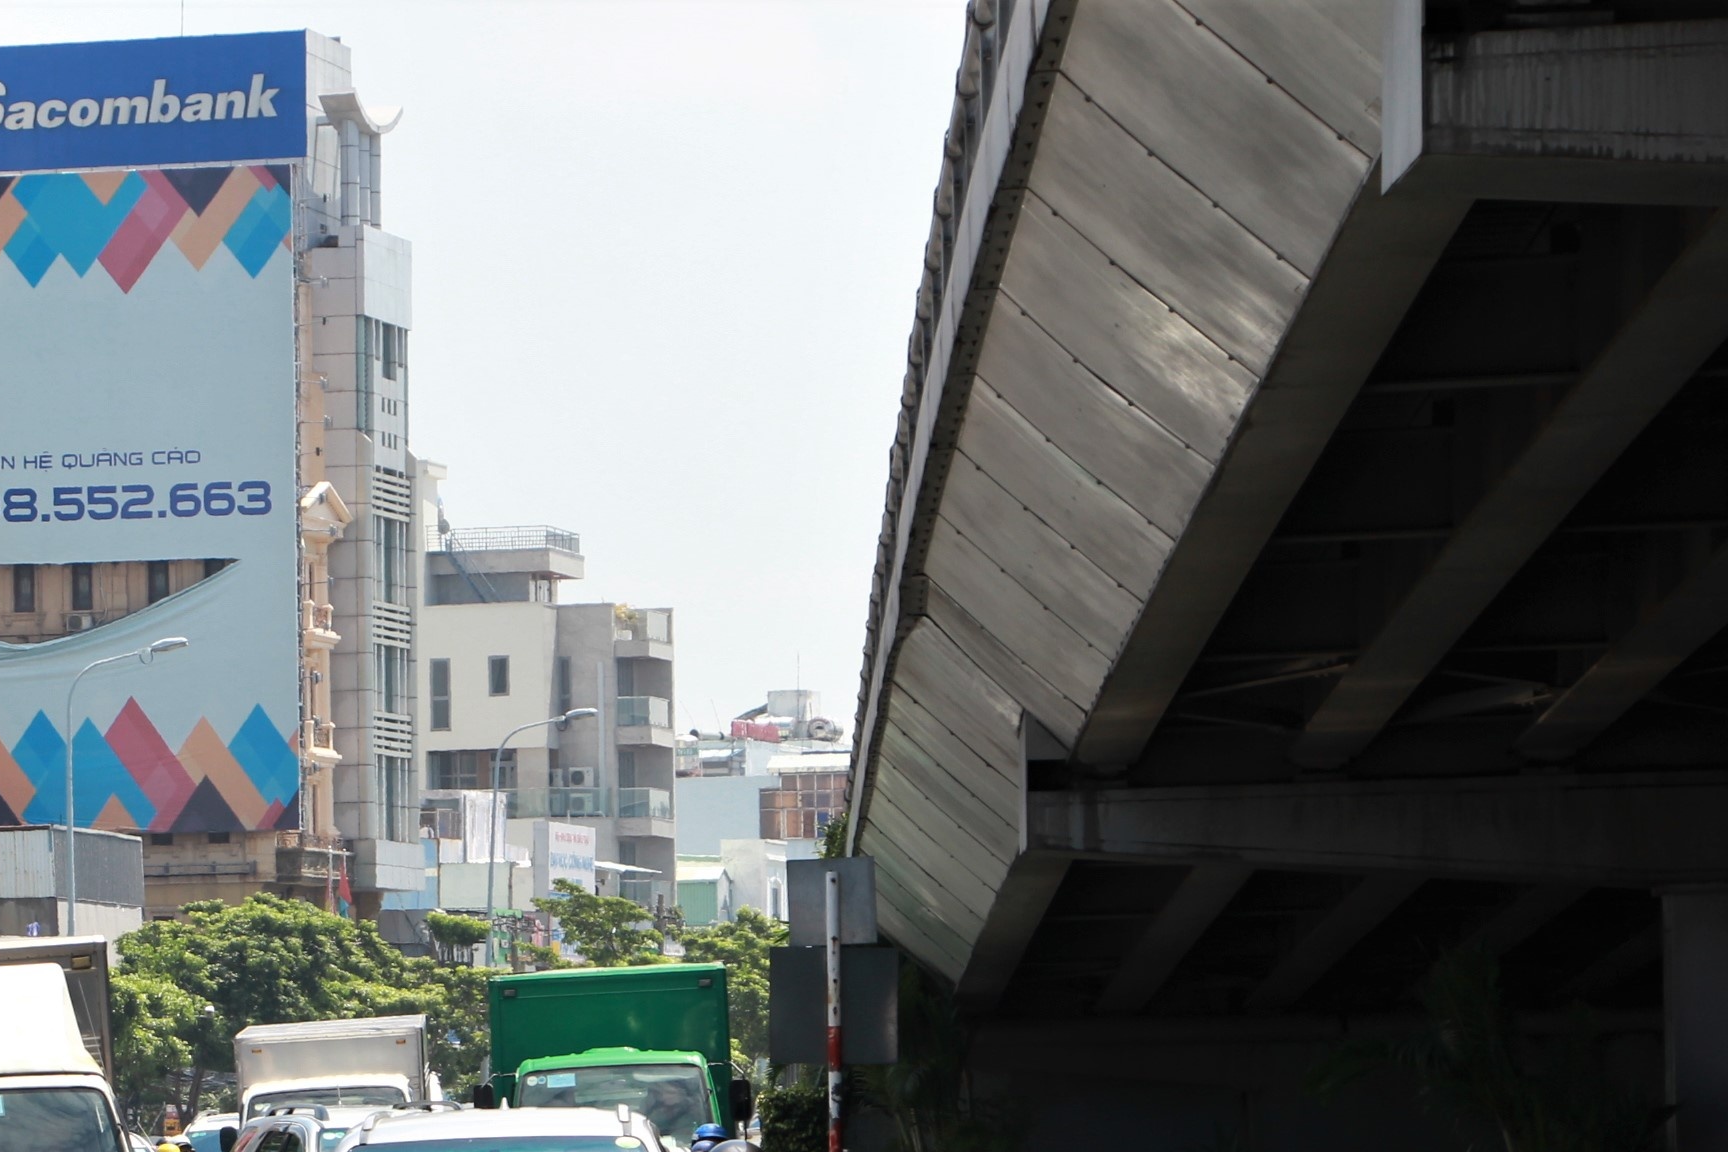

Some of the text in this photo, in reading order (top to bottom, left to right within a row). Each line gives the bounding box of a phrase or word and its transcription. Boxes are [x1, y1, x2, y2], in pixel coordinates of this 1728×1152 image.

[23, 450, 53, 473] HỆ
[61, 447, 143, 469] QUẢNG
[151, 446, 201, 465] CÁO
